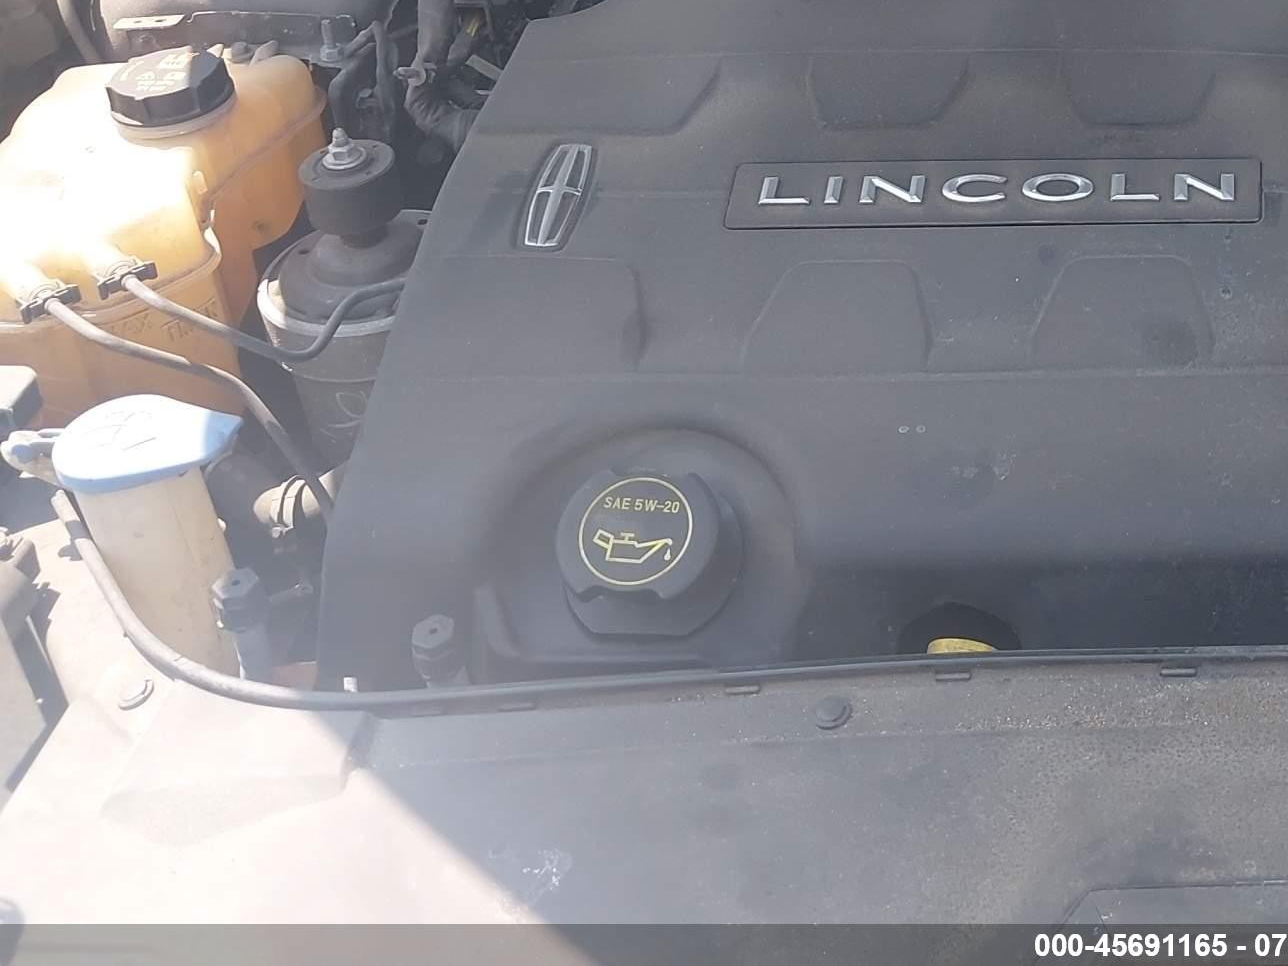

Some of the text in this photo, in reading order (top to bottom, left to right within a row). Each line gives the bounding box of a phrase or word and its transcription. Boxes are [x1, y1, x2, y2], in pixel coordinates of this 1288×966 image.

[757, 172, 1236, 206] LINCOLN
[603, 496, 681, 514] SAE 5W-20
